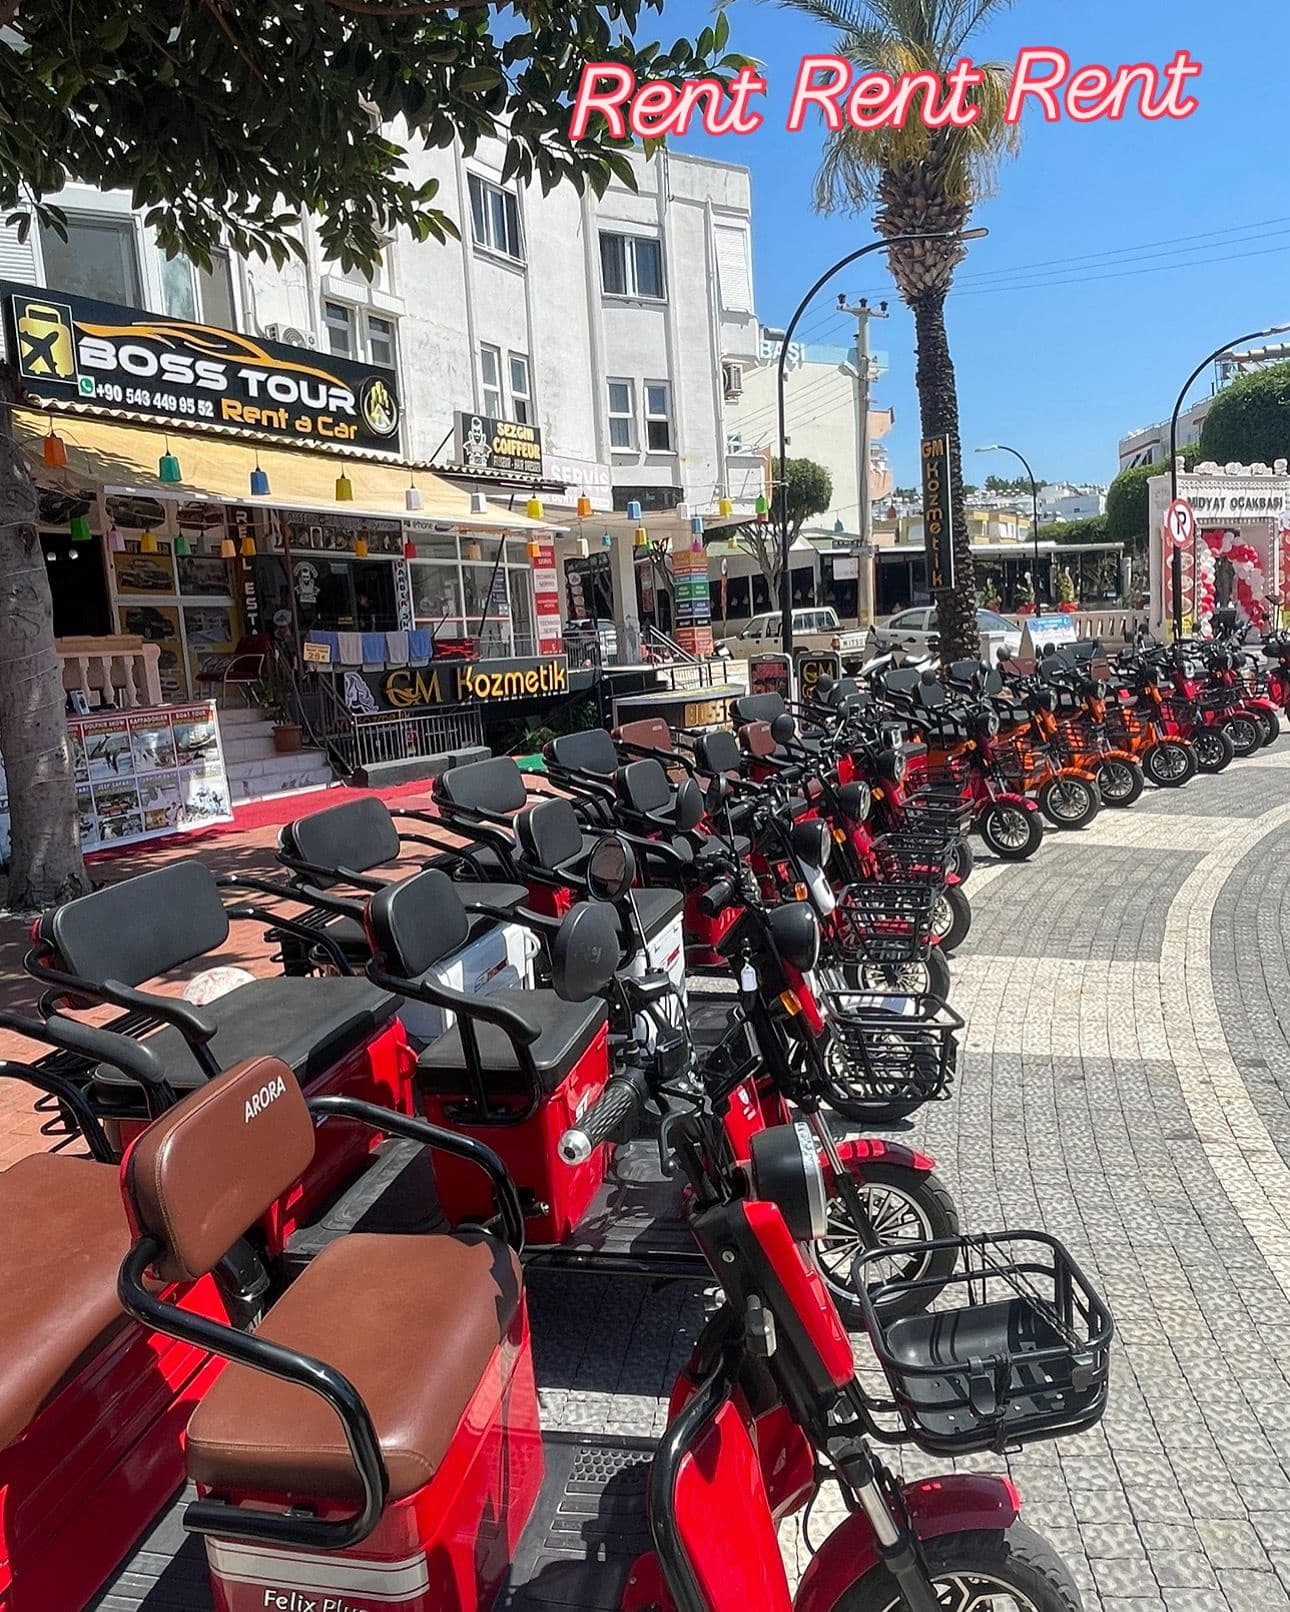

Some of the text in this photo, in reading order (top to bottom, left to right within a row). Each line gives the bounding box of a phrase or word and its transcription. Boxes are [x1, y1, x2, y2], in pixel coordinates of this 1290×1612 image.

[78, 336, 357, 416] BOSS TOUR
[96, 383, 214, 418] +90 543 449 95 52
[221, 398, 358, 440] Rent a Car
[493, 436, 541, 460] COIFFEUR
[922, 439, 944, 458] GM
[235, 510, 252, 571] REL
[385, 660, 567, 707] GM Kozmetik
[245, 1075, 287, 1124] ARORA
[264, 1589, 317, 1612] Felix
